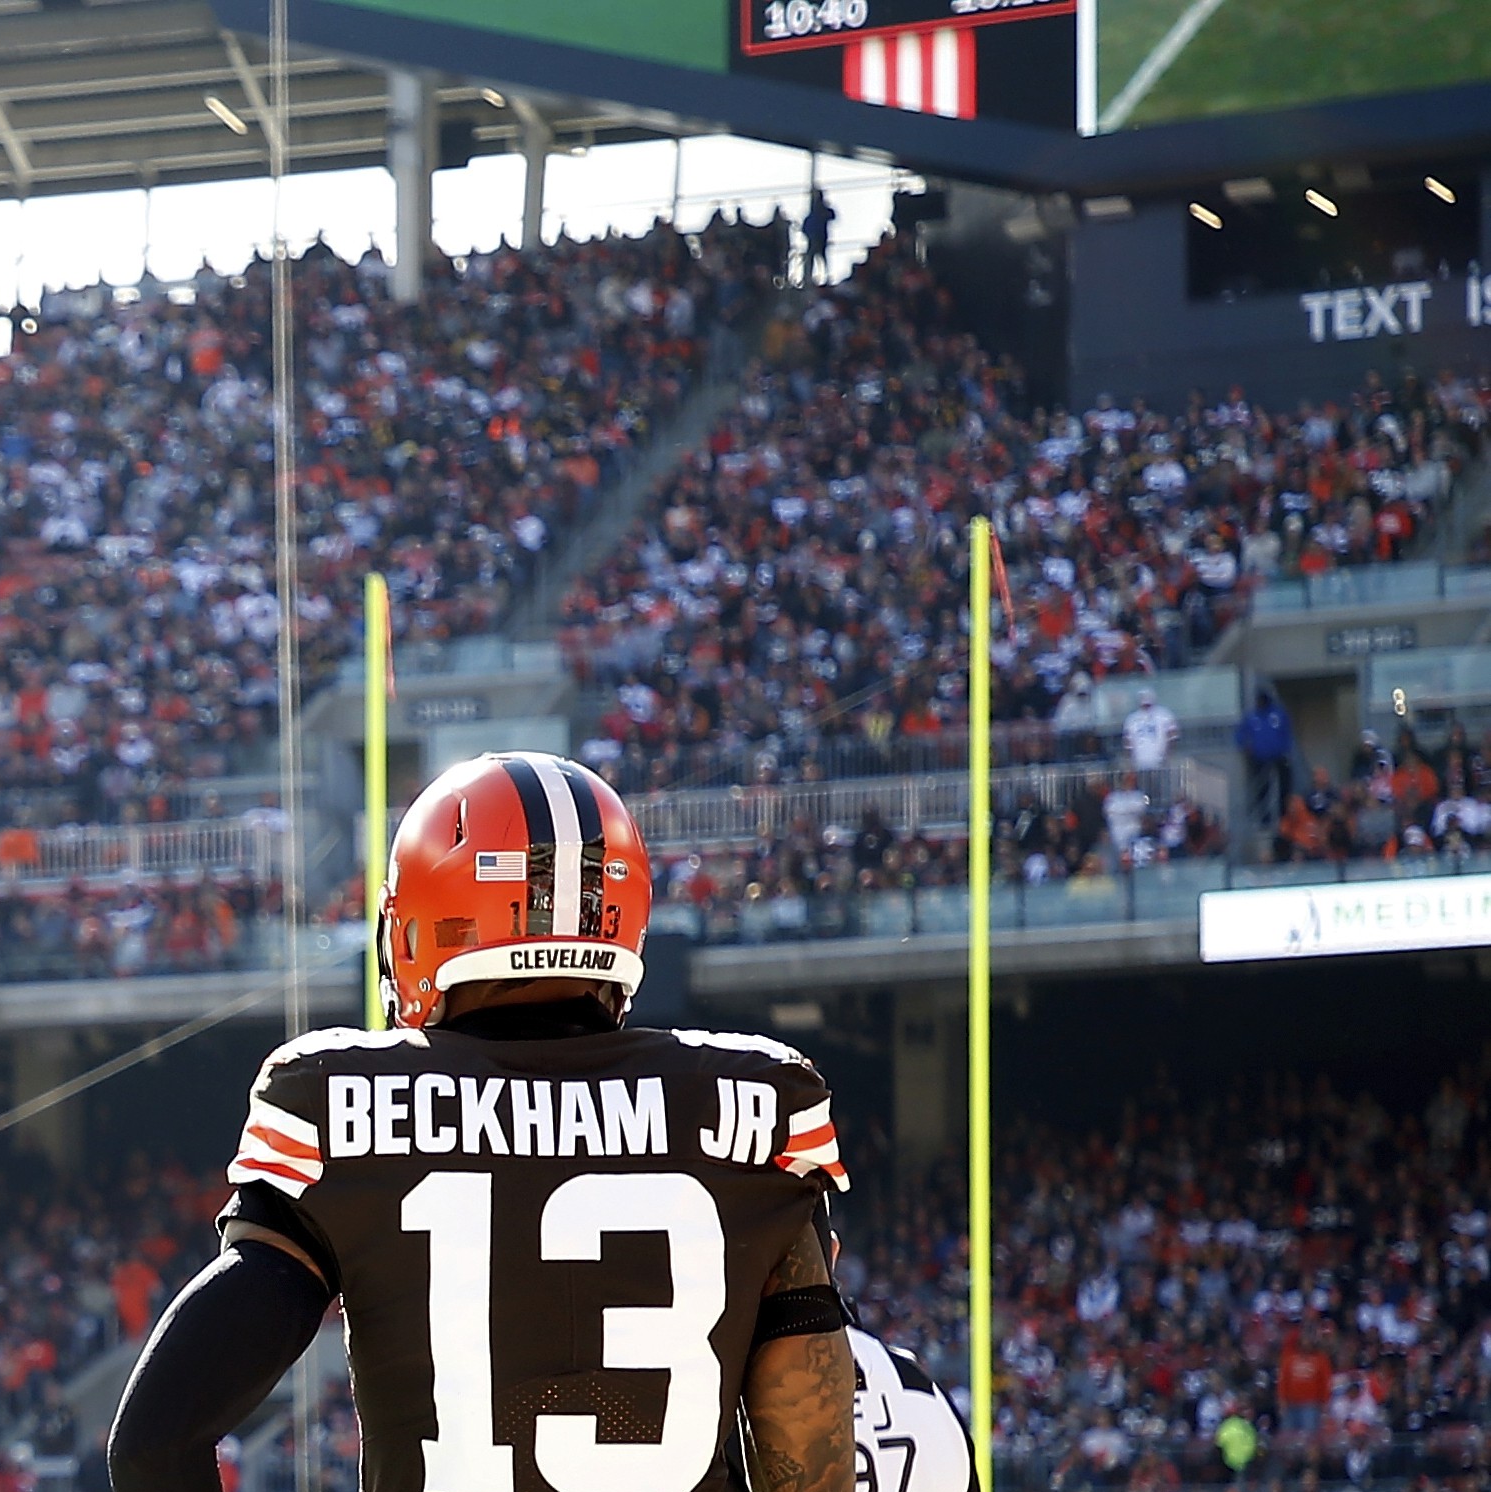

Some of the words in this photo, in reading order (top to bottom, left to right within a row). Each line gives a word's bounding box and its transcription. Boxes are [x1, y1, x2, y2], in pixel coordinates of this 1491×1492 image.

[1299, 280, 1433, 343] TEXT
[510, 950, 617, 971] CLEVELAND
[328, 1073, 668, 1158] BECKHAM
[700, 1077, 777, 1165] JR
